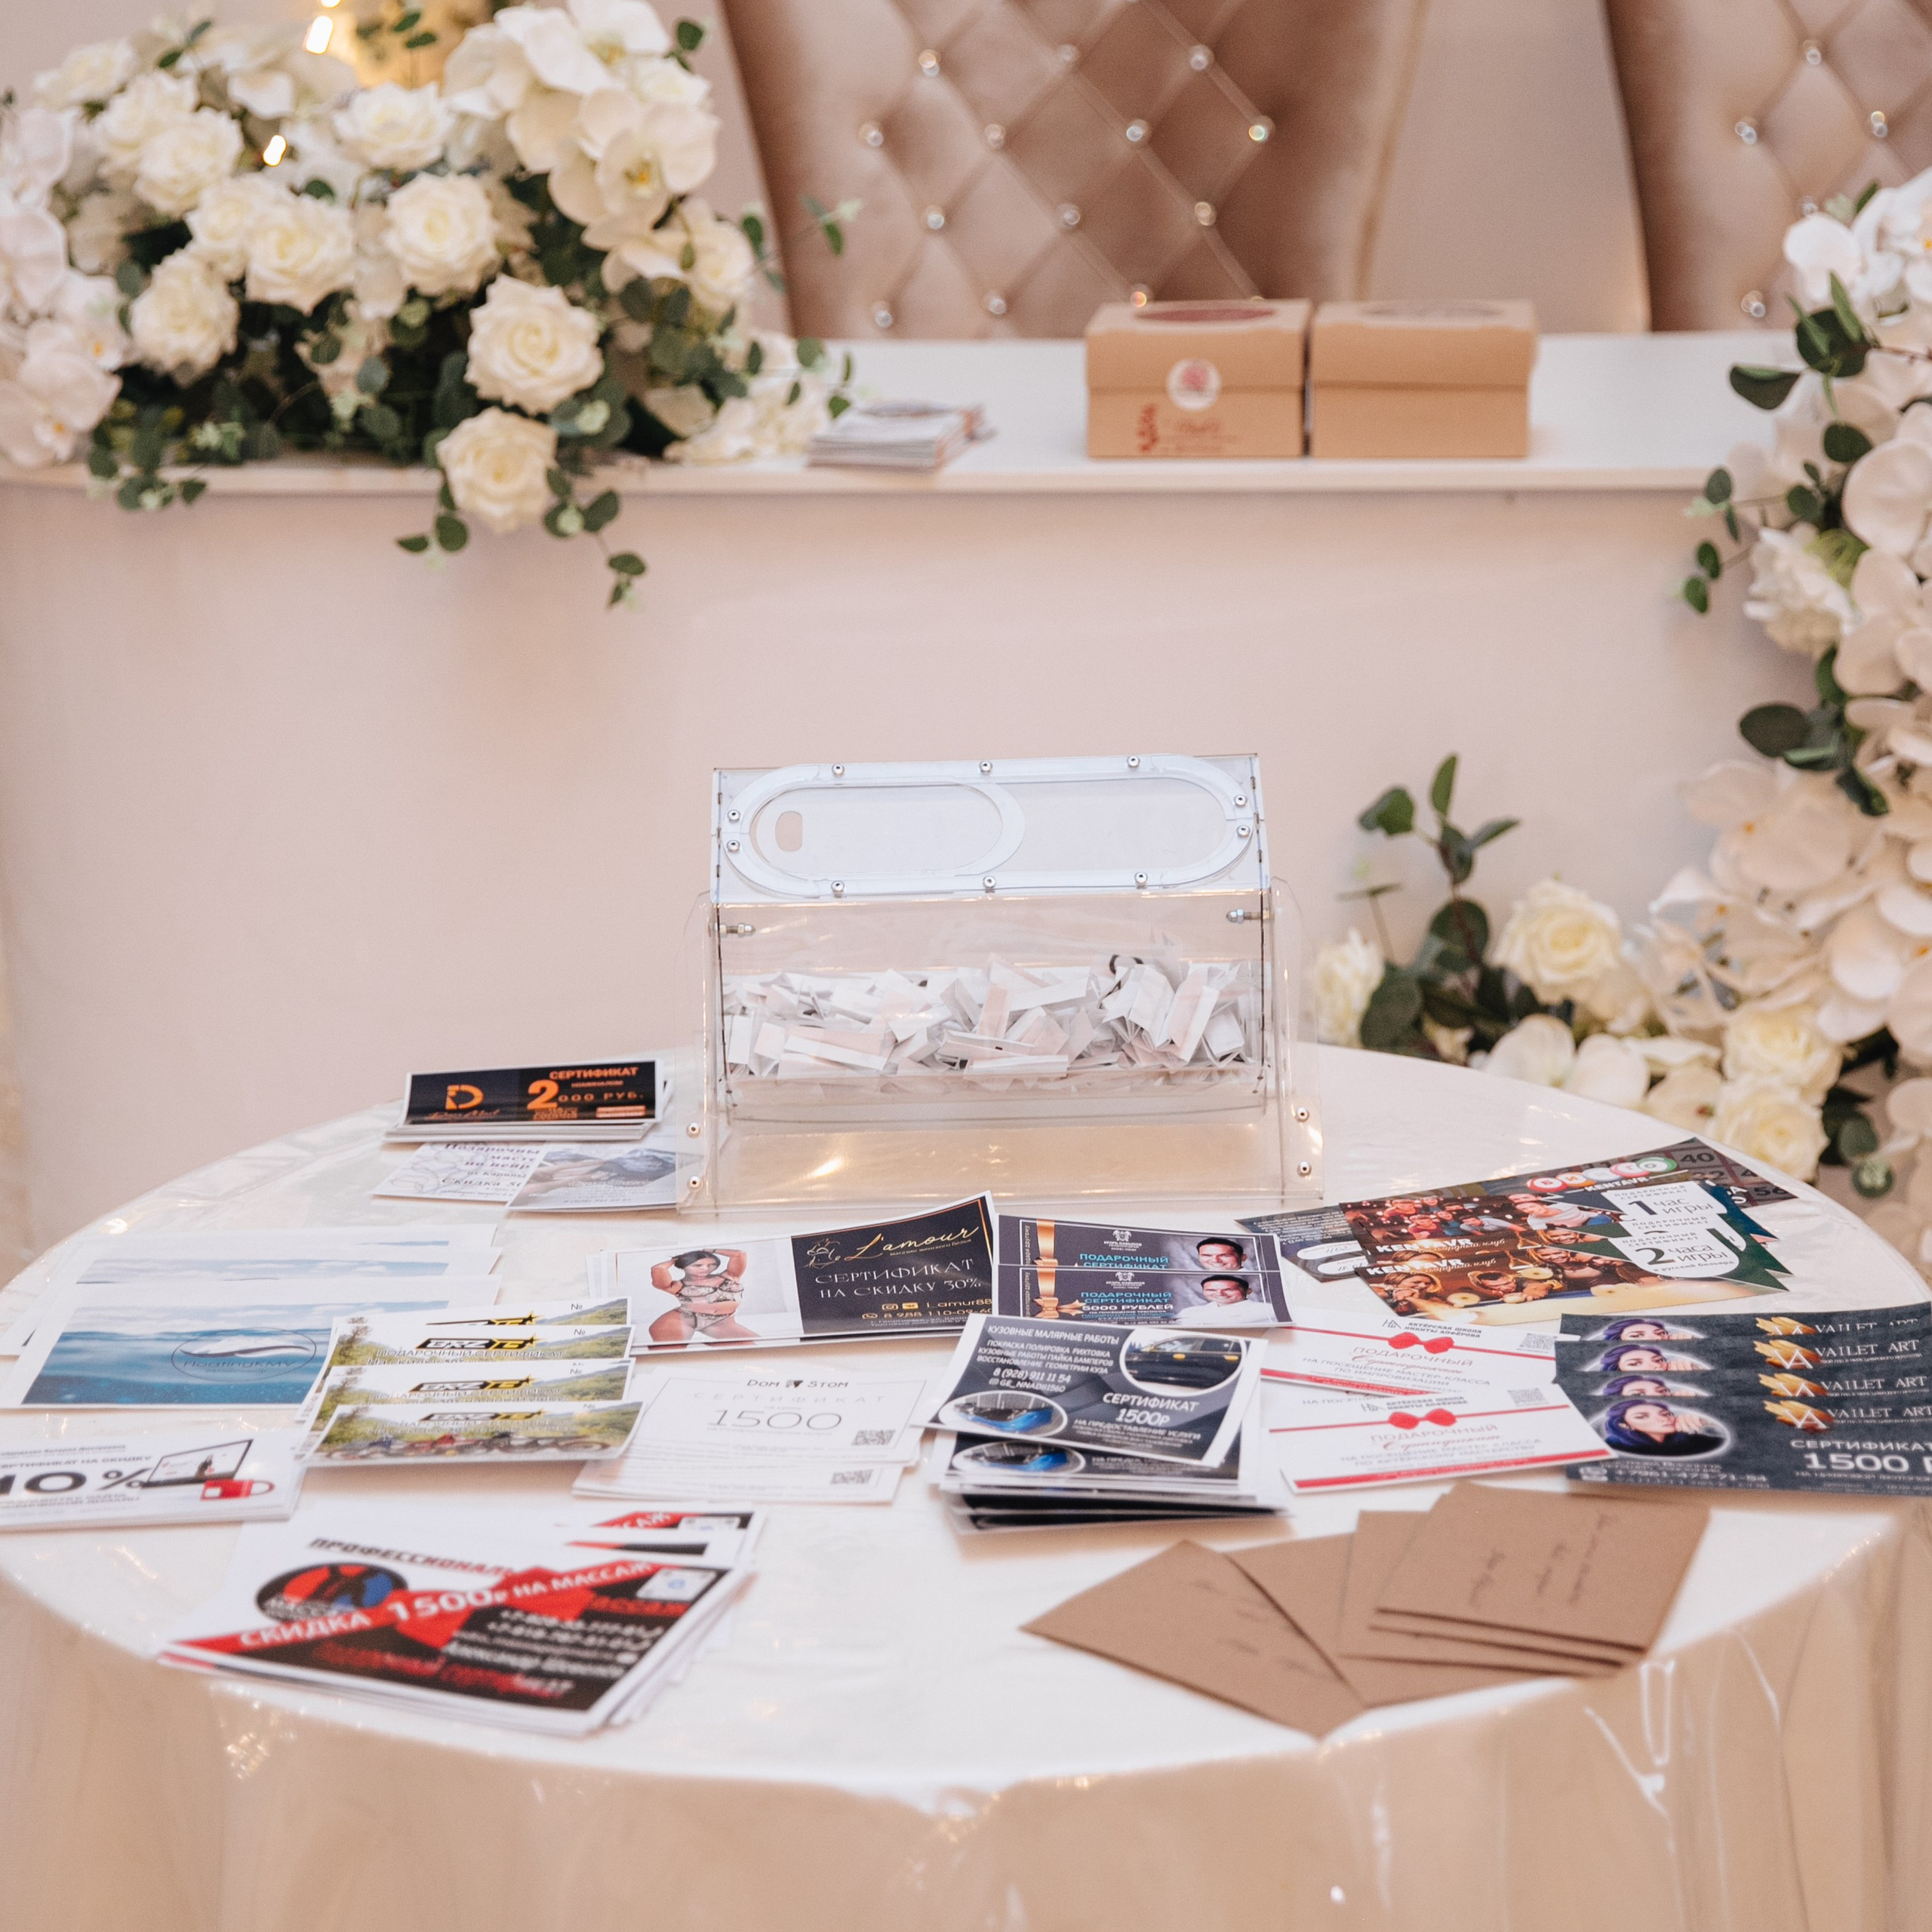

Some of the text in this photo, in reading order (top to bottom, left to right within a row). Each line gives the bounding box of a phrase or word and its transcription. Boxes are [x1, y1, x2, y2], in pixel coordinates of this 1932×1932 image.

[549, 1067, 638, 1080] СЕРТИФИКАТ
[445, 1143, 540, 1154] Подарочны
[1681, 1152, 1715, 1163] 40
[1585, 1176, 1650, 1192] KENTAVR
[1628, 1201, 1658, 1216] 1
[1654, 1198, 1690, 1208] час
[1662, 1203, 1714, 1214] игры
[844, 1226, 980, 1261] L'amour
[1376, 1238, 1472, 1253] KENTAVR
[1669, 1244, 1715, 1254] часа
[1079, 1253, 1169, 1263] ПОДАРОЧНЫЙ
[1635, 1247, 1675, 1266] 2
[1677, 1251, 1727, 1263] игры
[815, 1258, 974, 1284] СЕРТИФИКАТ
[1366, 1259, 1466, 1275] KENTAVR
[820, 1277, 981, 1299] НА СКИДКУ 30%
[988, 1324, 1119, 1345] КУЗОВНЫЕ МАЛЯРНЫЕ РАБОТЫ
[377, 1349, 565, 1358] ПОДАРОЧНЫЙ СЕРТИФИКАТ
[987, 1340, 1110, 1358] ПОКРАСКА ПОЛИРОВКА РИХТОВКА
[1353, 1346, 1473, 1367] ПОДАРОЧНЫЙ
[1814, 1340, 1919, 1357] VAILET ART
[977, 1355, 1043, 1367] ВОССТАНОВЛЕНИЕ
[1045, 1361, 1089, 1373] ГЕОМЕТРИИ
[978, 1348, 1114, 1367] КУЗОВНЫЕ РАБОТЫ ПАЙКА БАМПЕРОВ
[1321, 1359, 1394, 1373] ПОСЕЩЕНИЕ
[993, 1367, 1001, 1376] 8
[1001, 1368, 1029, 1379] (928)
[1046, 1373, 1057, 1382] 11
[1057, 1374, 1071, 1383] 54
[1358, 1368, 1450, 1386] ИМПРОВИЗАЦИИ
[1820, 1377, 1927, 1391] VAILET ART
[693, 1392, 886, 1404] СЕРТИФИКАТ
[1103, 1392, 1199, 1412] СЕРТИФИКАТ
[707, 1409, 842, 1430] 1500
[1826, 1406, 1932, 1418] VAILET ART
[1371, 1424, 1498, 1442] ПОДАРОЧНЫЙ
[0, 1460, 78, 1469] ЕРТИФИКАТ
[102, 1455, 152, 1463] СКИДКУ
[1804, 1451, 1910, 1472] 1500
[240, 1612, 372, 1646] СКИДКА
[513, 1582, 548, 1598] НА
[551, 1561, 654, 1591] МАССАЖ
